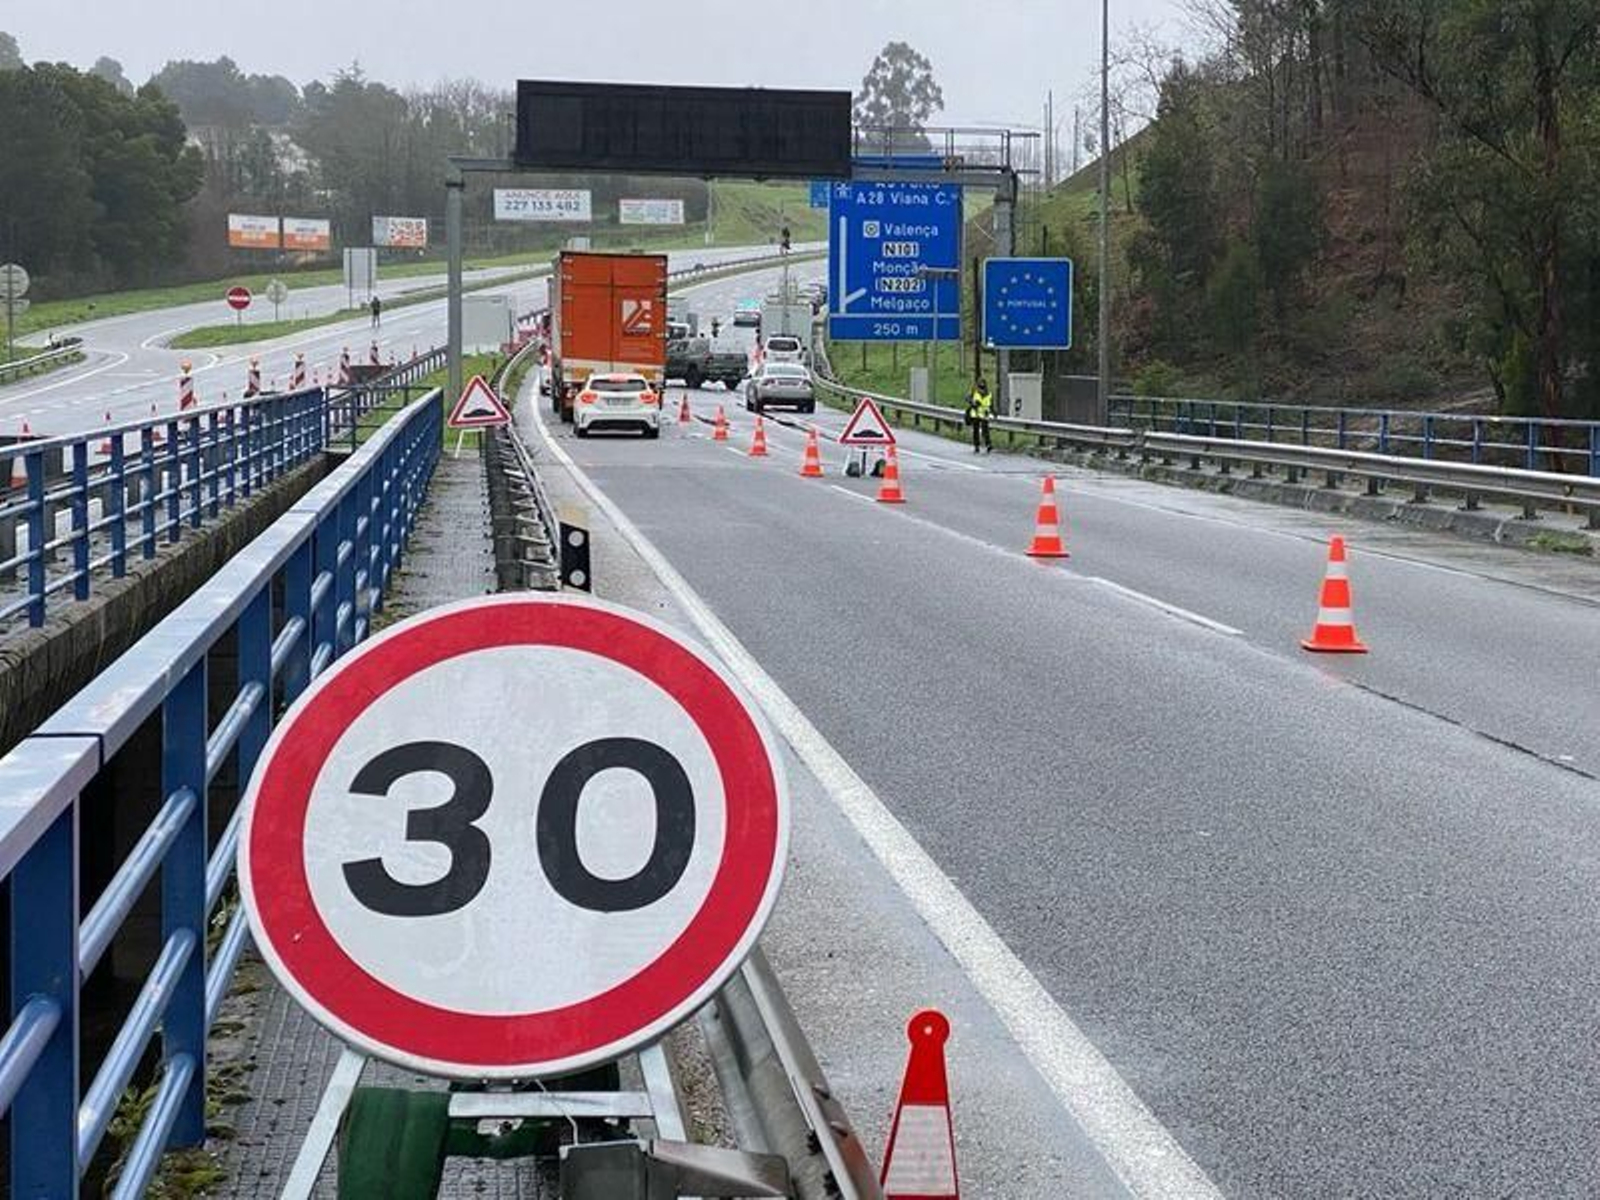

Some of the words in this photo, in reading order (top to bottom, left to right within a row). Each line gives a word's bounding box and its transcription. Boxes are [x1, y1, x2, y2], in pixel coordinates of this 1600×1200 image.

[857, 191, 884, 205] A28
[890, 191, 929, 205] Viana
[505, 201, 528, 211] 227
[884, 222, 939, 238] Valença
[884, 243, 917, 256] N101
[871, 296, 930, 312] Melgaço
[873, 322, 900, 336] 250
[906, 325, 918, 335] m
[342, 736, 696, 917] 30
